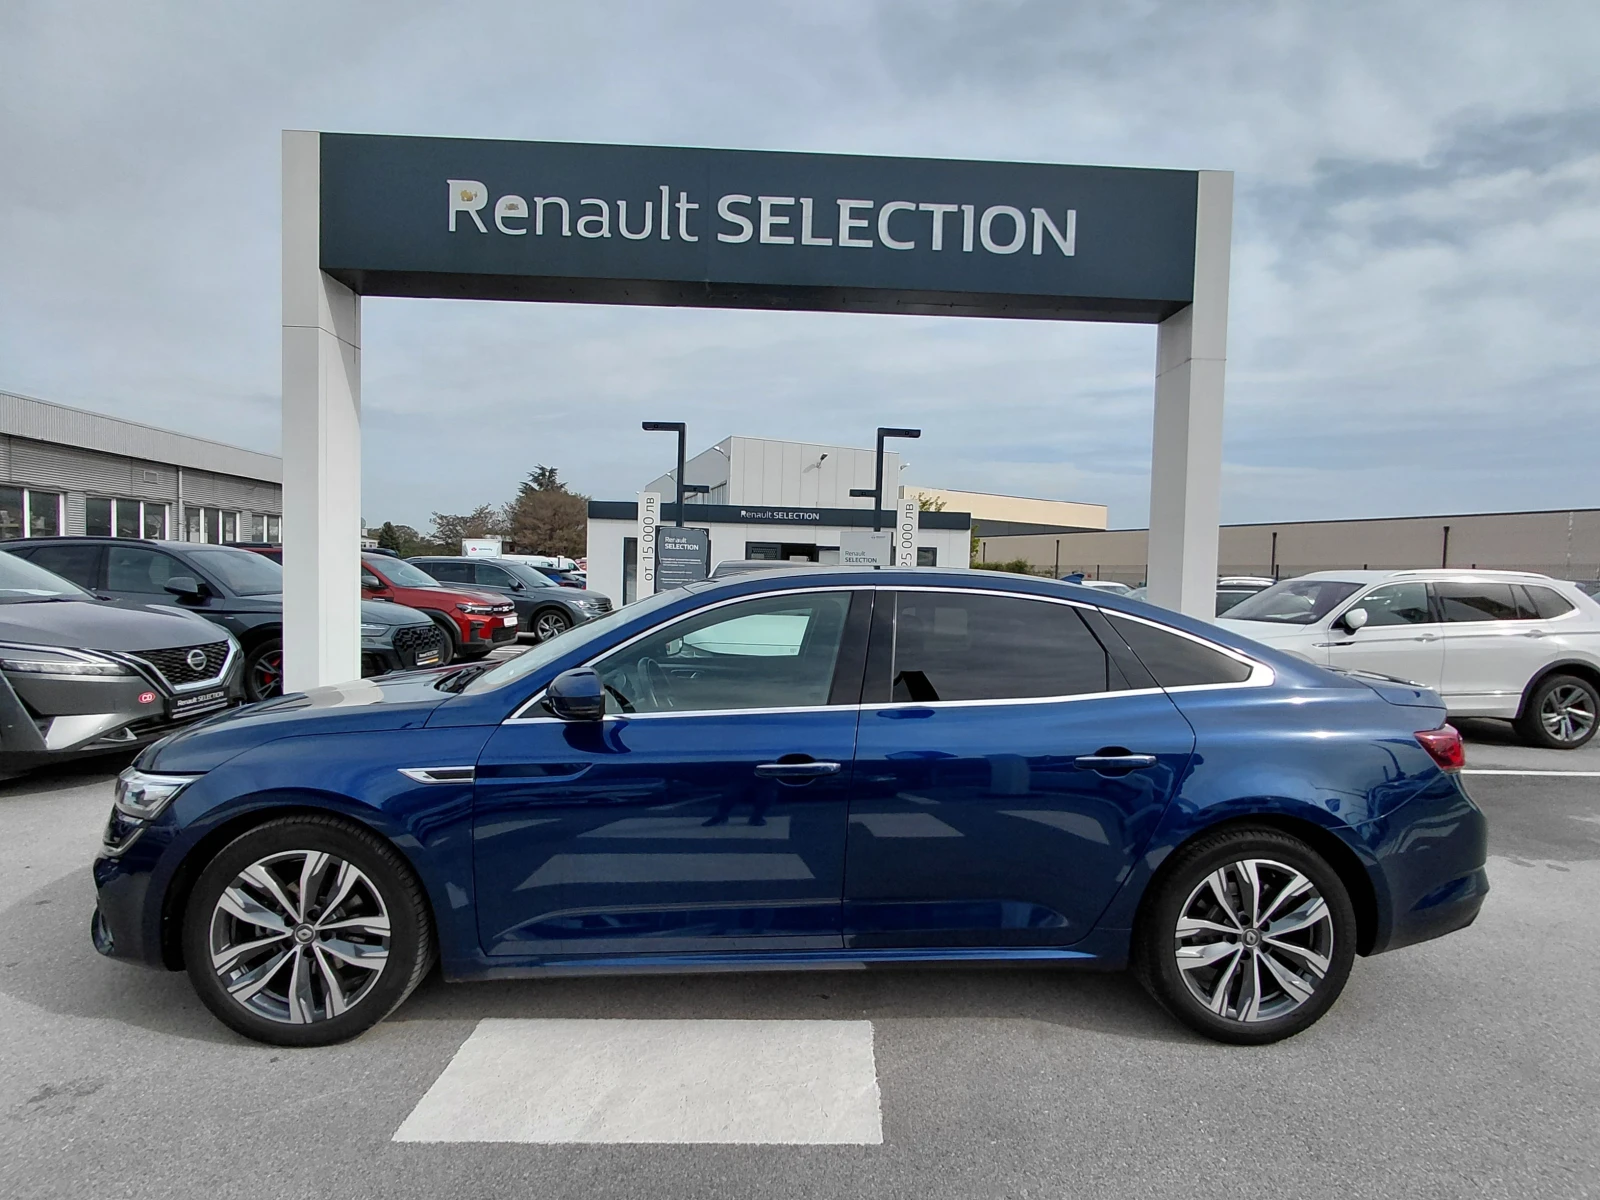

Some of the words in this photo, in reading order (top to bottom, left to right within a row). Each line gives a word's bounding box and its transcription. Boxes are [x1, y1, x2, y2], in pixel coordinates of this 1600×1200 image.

[446, 179, 700, 243] Renault
[717, 193, 1077, 257] SELECTION
[740, 510, 773, 519] Renault
[773, 511, 820, 520] SELECTION
[642, 516, 655, 543] 000
[901, 523, 914, 549] 000
[642, 546, 654, 562] 15
[664, 543, 699, 551] SELECTION
[900, 552, 913, 567] 25
[177, 697, 198, 707] Renault
[198, 691, 224, 702] SELECTION
